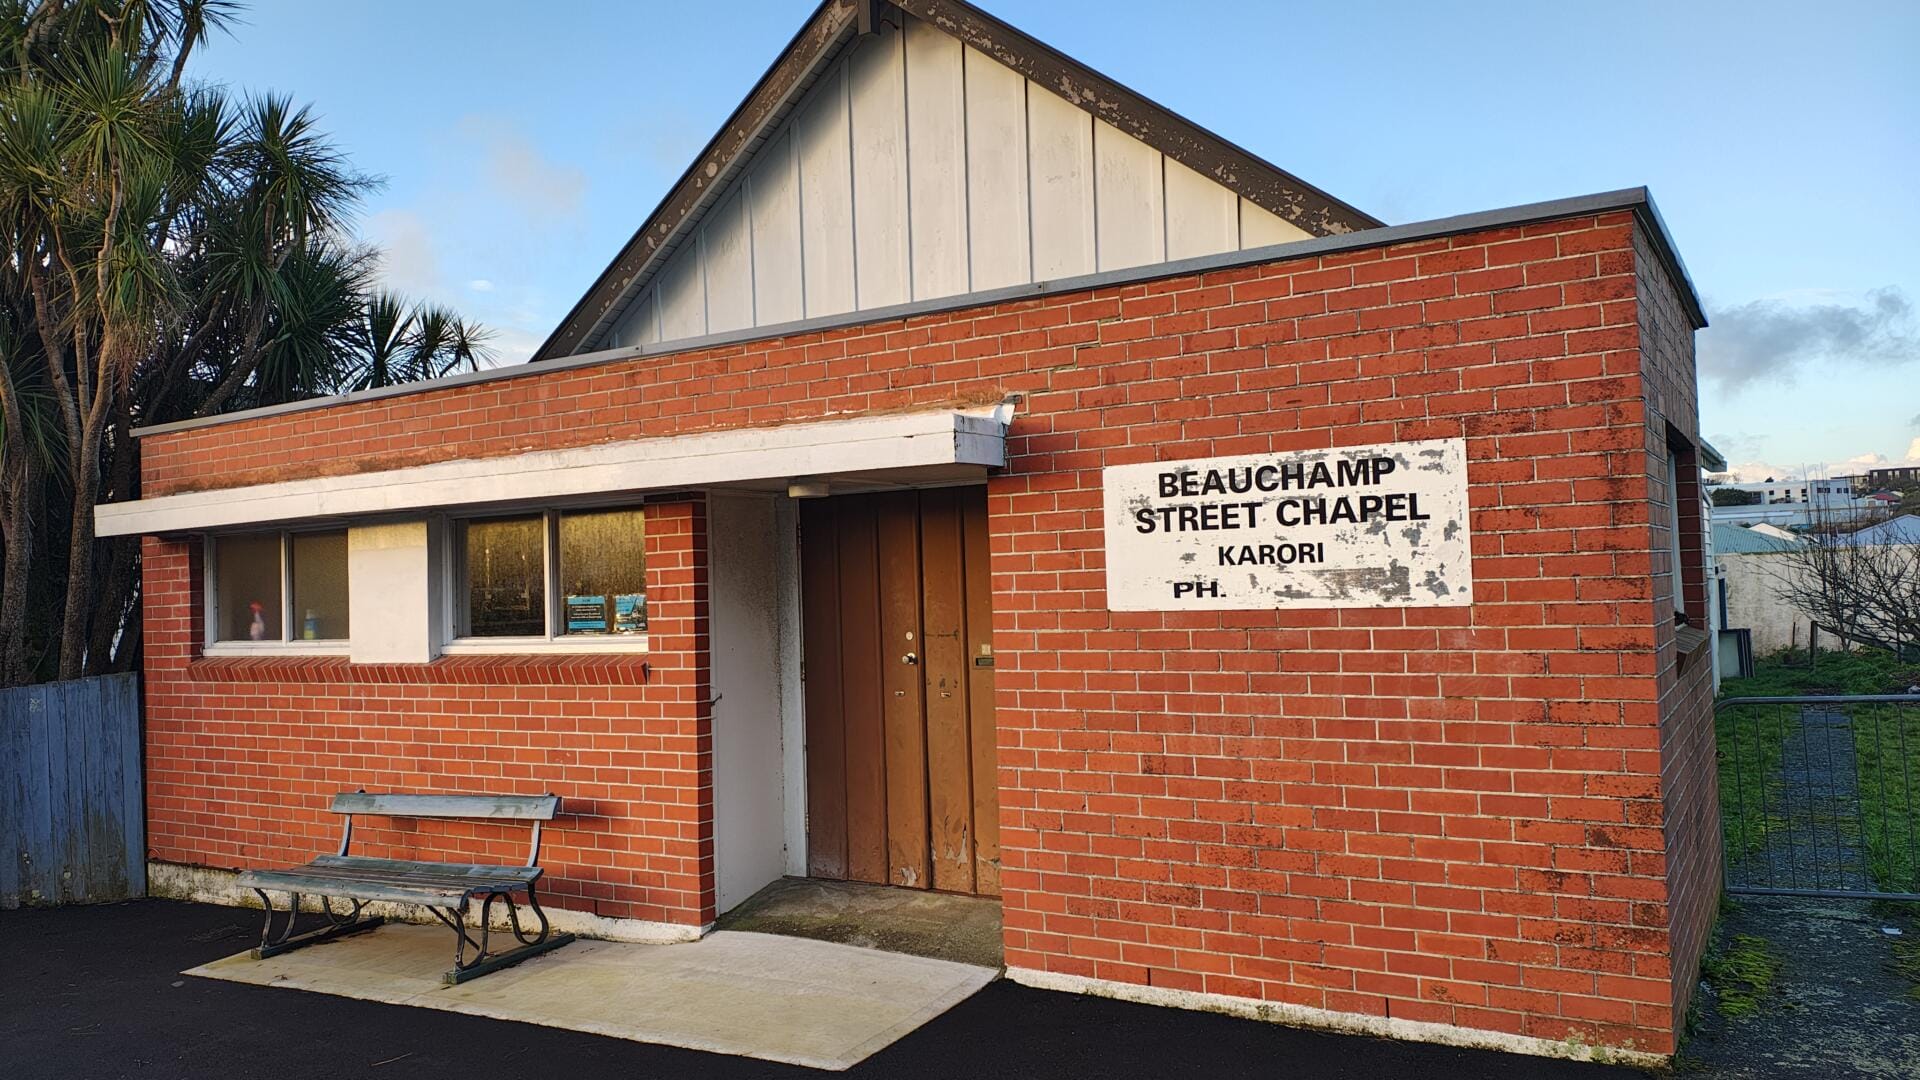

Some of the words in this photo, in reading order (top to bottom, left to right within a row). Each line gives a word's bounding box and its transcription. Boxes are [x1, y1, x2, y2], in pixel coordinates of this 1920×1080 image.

[1158, 457, 1396, 498] BEAUCHAMP
[1135, 501, 1263, 534] STREET
[1276, 492, 1431, 527] CHAPEL
[1218, 542, 1325, 566] KARORI
[1173, 581, 1227, 599] PH.
